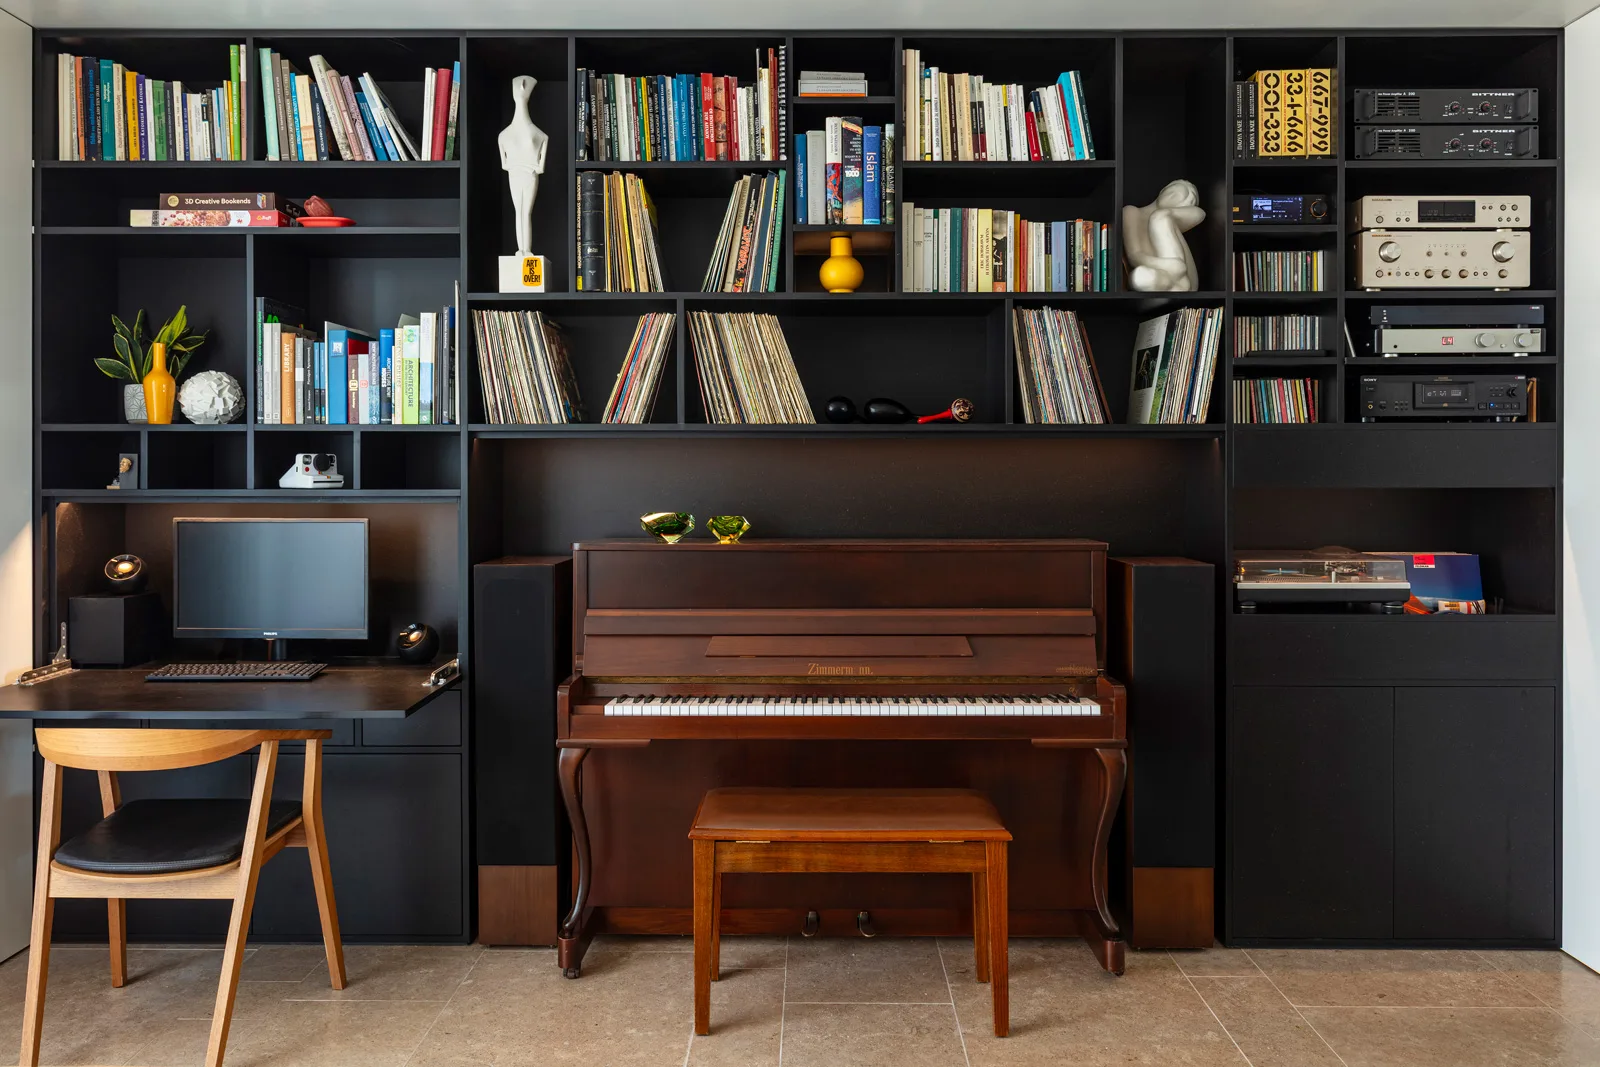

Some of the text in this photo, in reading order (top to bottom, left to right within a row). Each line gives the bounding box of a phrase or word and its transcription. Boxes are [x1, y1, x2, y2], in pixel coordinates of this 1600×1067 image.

[866, 152, 877, 182] Islam
[529, 267, 535, 275] IS
[808, 663, 874, 675] Zimmermnn.
